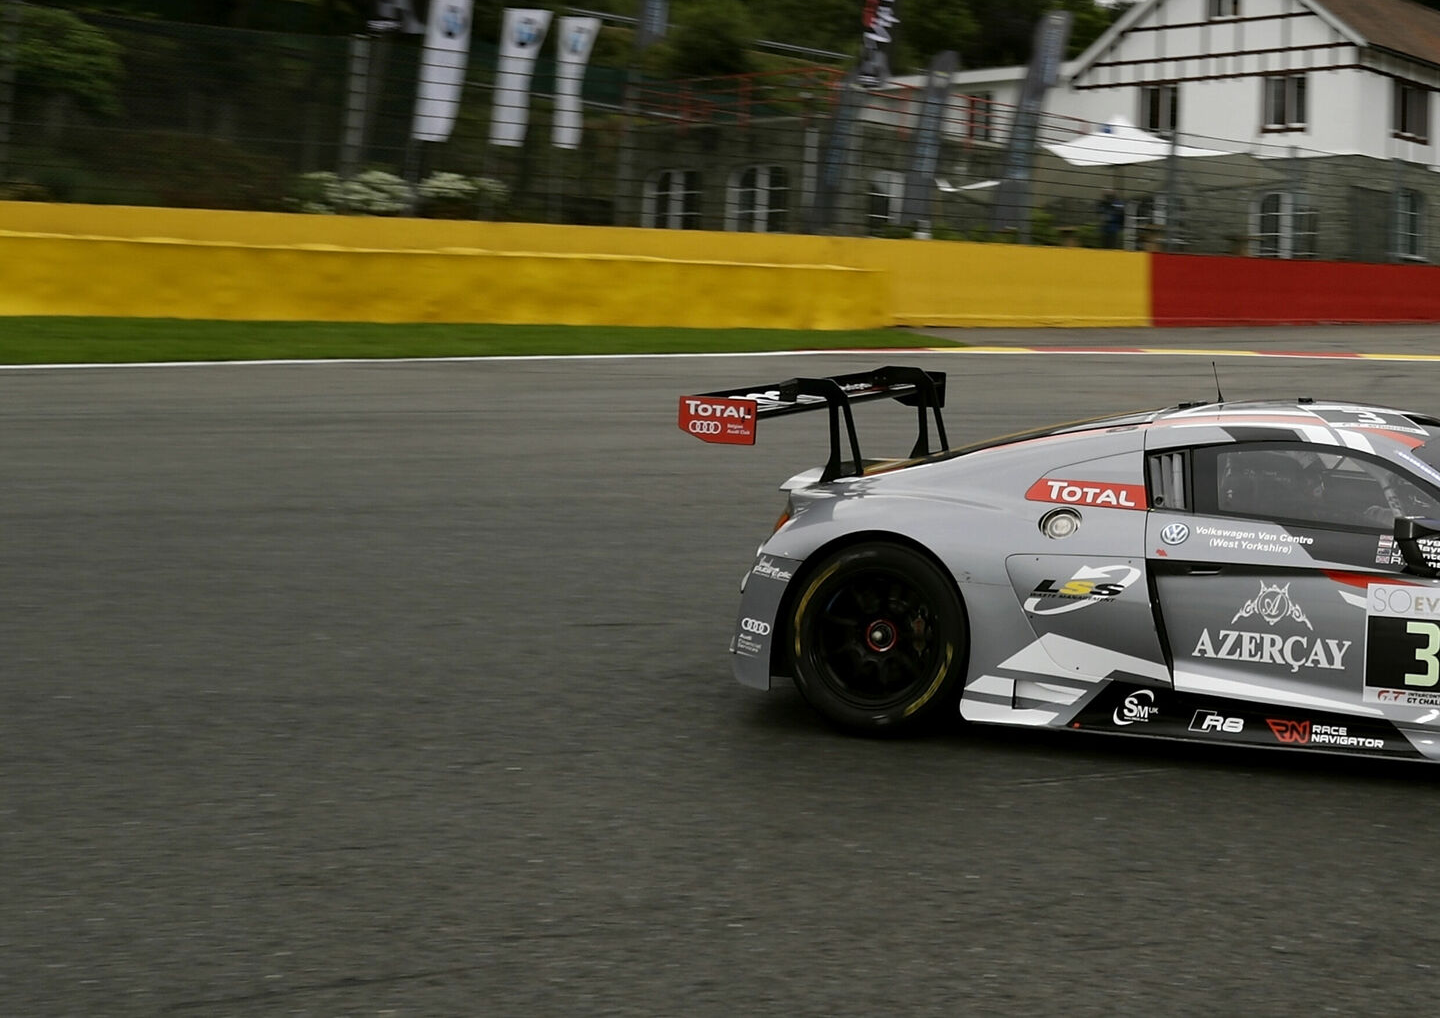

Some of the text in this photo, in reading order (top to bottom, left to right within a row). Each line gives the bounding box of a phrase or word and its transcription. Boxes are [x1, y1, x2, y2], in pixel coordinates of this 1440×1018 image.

[685, 399, 752, 419] TOTAL
[1047, 480, 1136, 508] TOTAL
[1195, 526, 1314, 545] Volkswagen Van Centre
[1209, 537, 1293, 555] (West Yorkshire)
[1033, 579, 1125, 596] LSS
[1191, 627, 1352, 673] AZERÇAY
[1202, 715, 1245, 733] R8
[1312, 724, 1348, 736] RACE
[1311, 734, 1385, 748] NAVIGATOR
